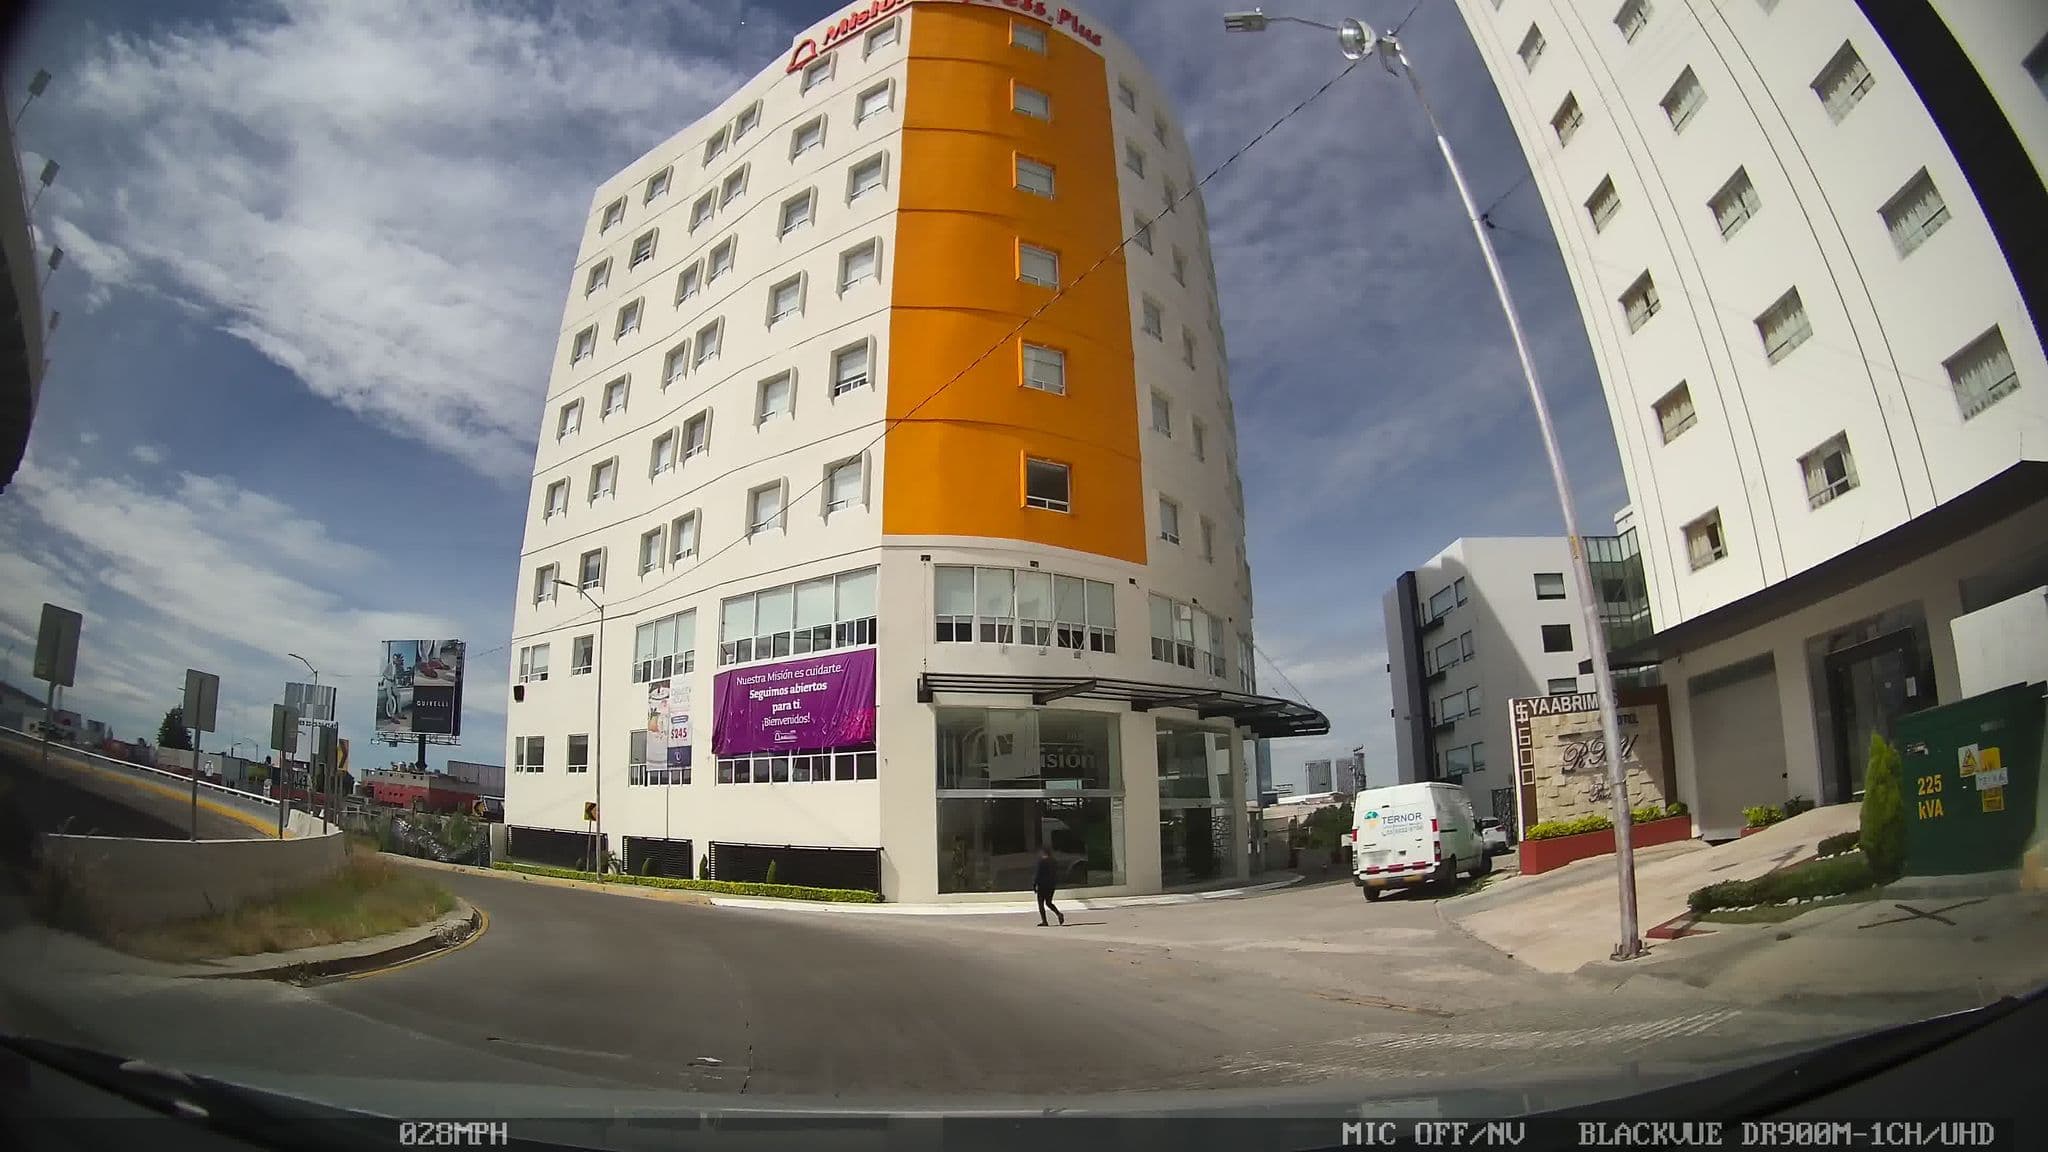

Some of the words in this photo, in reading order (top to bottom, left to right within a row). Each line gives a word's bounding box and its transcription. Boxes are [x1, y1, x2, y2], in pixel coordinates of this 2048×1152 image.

[1057, 8, 1102, 46] Plus
[736, 673, 766, 686] Nuestra
[767, 668, 793, 682] Misión
[794, 669, 805, 678] es
[805, 664, 844, 677] cuidarte.
[749, 686, 789, 701] Seguimos
[789, 682, 828, 695] abiertos
[772, 702, 792, 715] para
[761, 712, 811, 732] ¡Bienvenidos!
[671, 728, 688, 740] $245
[1040, 746, 1097, 769] isión
[1917, 774, 1942, 796] 225
[1382, 812, 1422, 825] TERNOR
[1918, 799, 1944, 820] kVA
